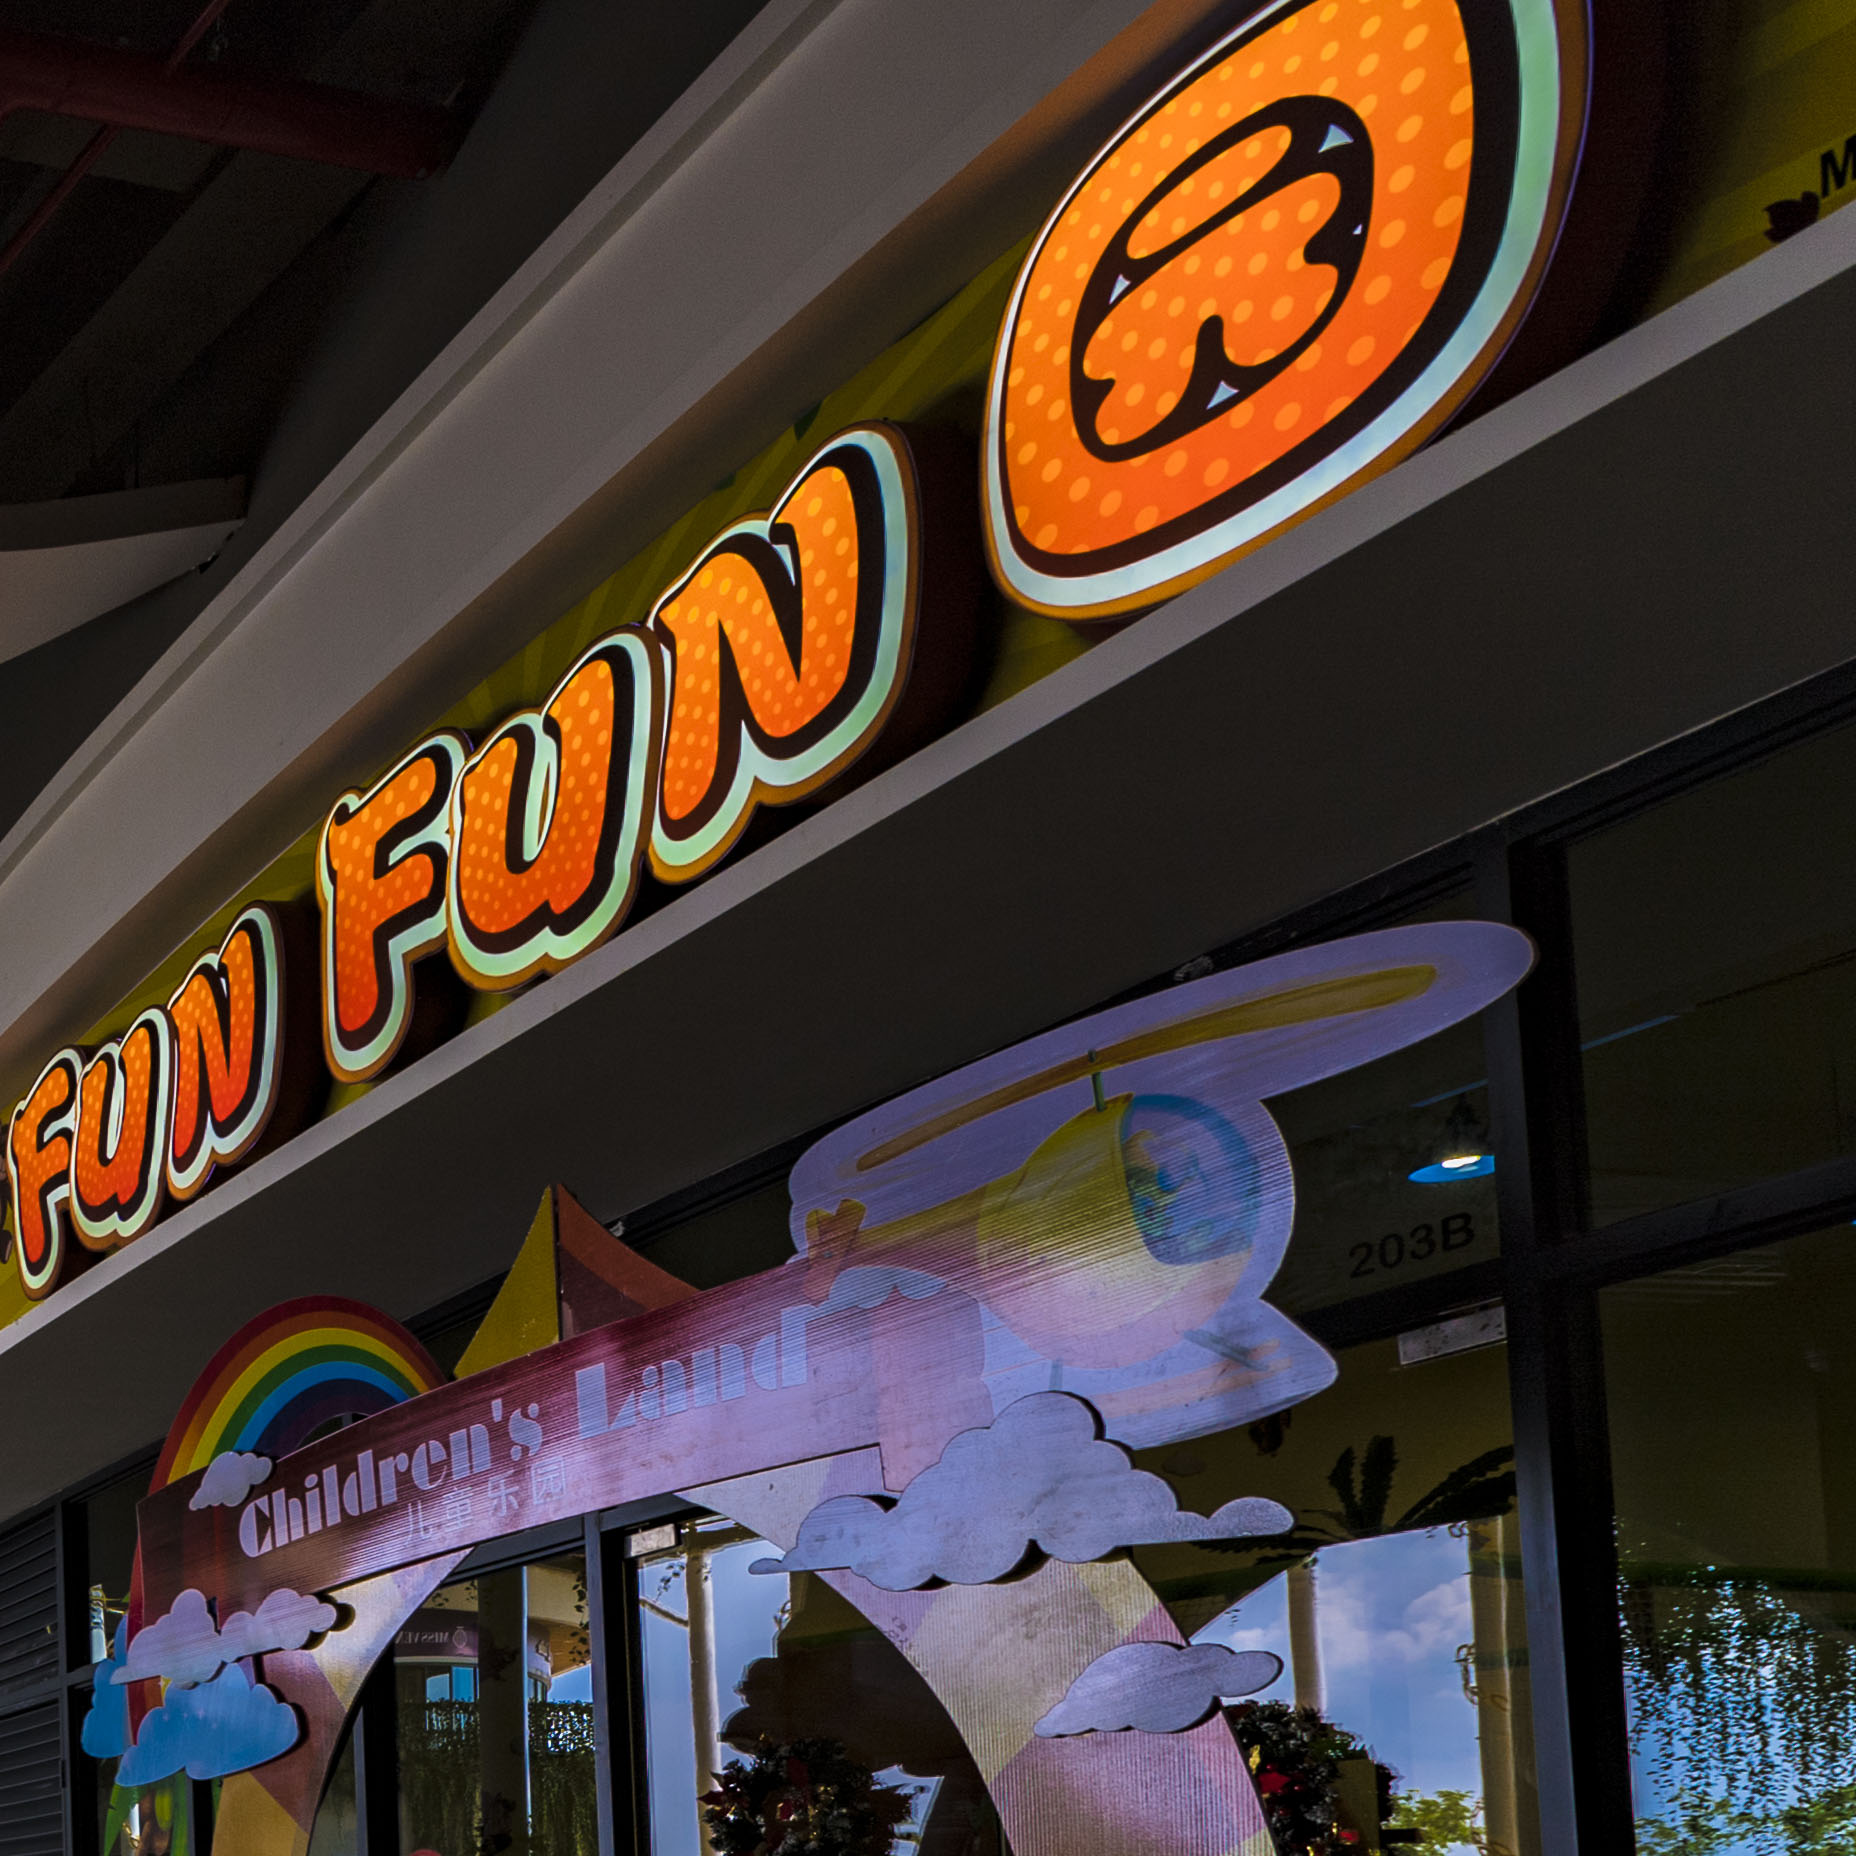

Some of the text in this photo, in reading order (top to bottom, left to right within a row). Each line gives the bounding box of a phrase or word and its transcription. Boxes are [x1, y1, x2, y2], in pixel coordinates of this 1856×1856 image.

[6, 421, 919, 1300] FUN FUN
[1349, 1211, 1474, 1279] 203B
[239, 1304, 808, 1558] Children's Land
[403, 1456, 567, 1545] 儿童乐园
